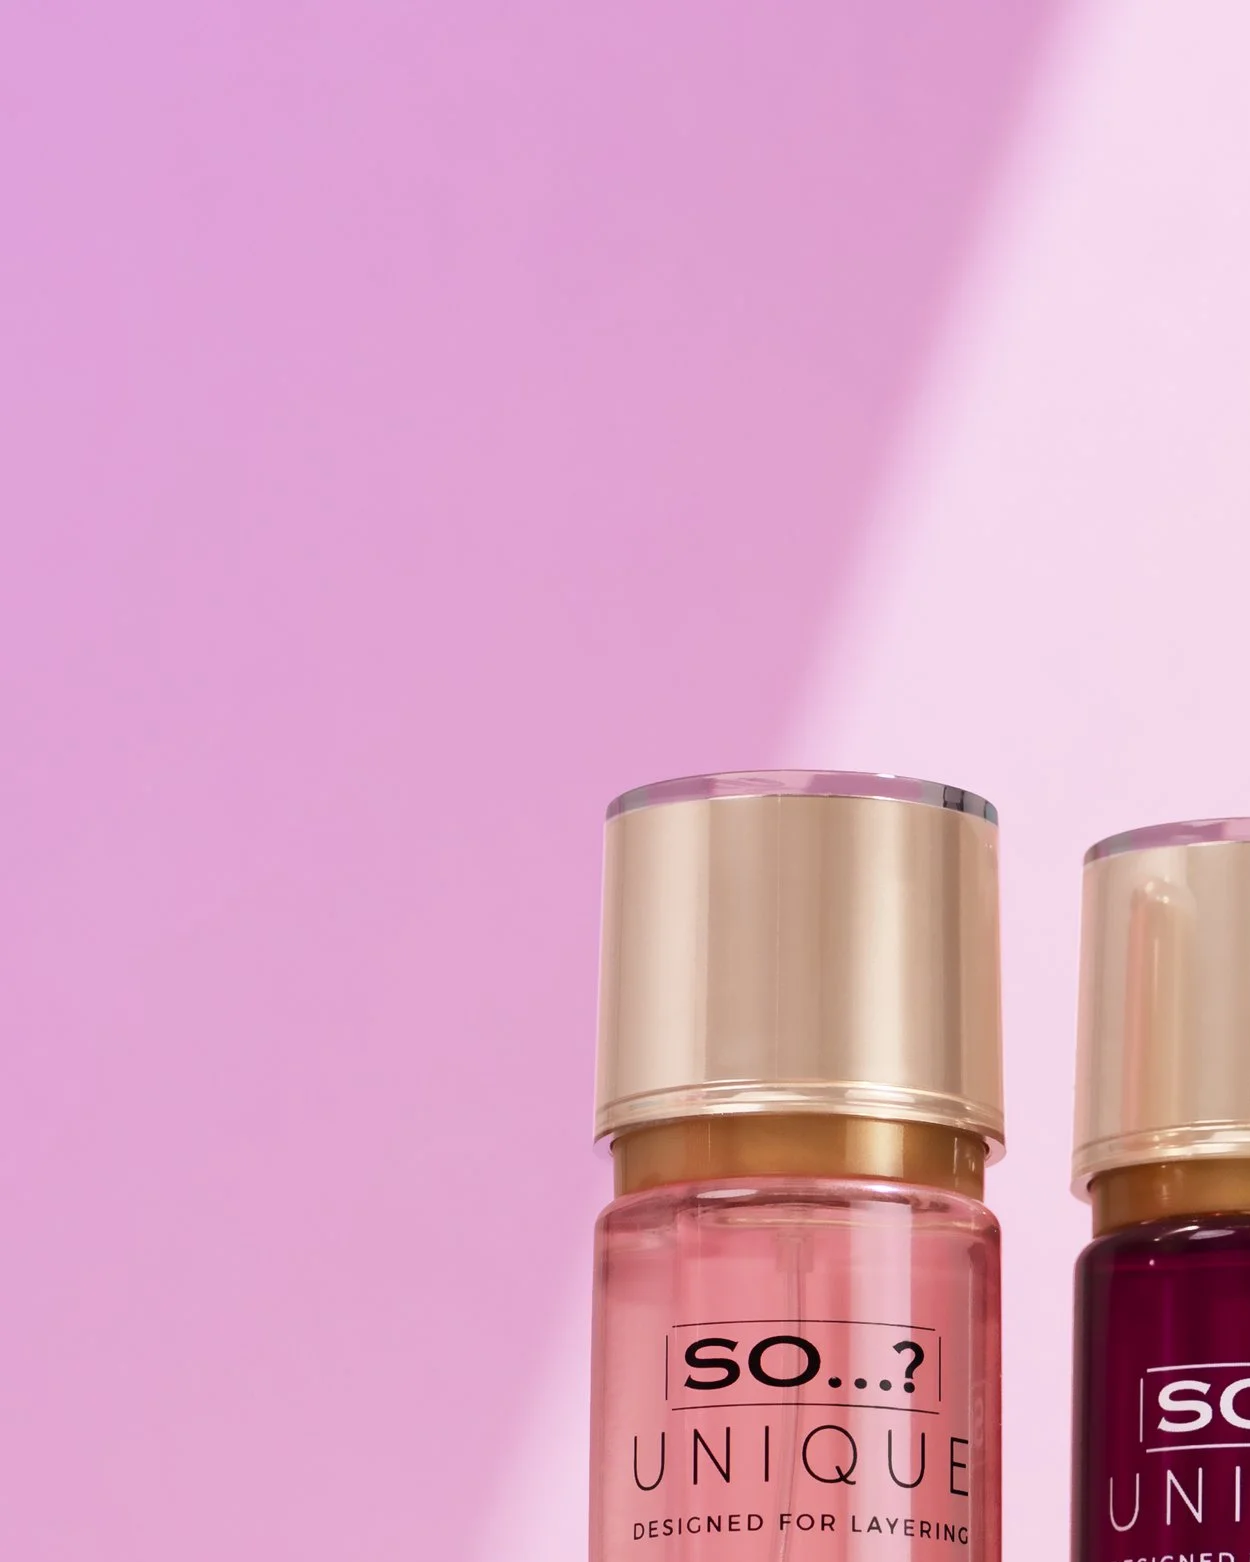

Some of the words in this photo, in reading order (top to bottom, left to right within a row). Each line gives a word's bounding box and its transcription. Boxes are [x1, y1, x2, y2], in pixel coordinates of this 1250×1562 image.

[632, 1424, 969, 1497] UNIQUE
[633, 1513, 764, 1541] DESIGNED
[779, 1513, 836, 1532] FOR
[851, 1514, 969, 1545] LAYERING
